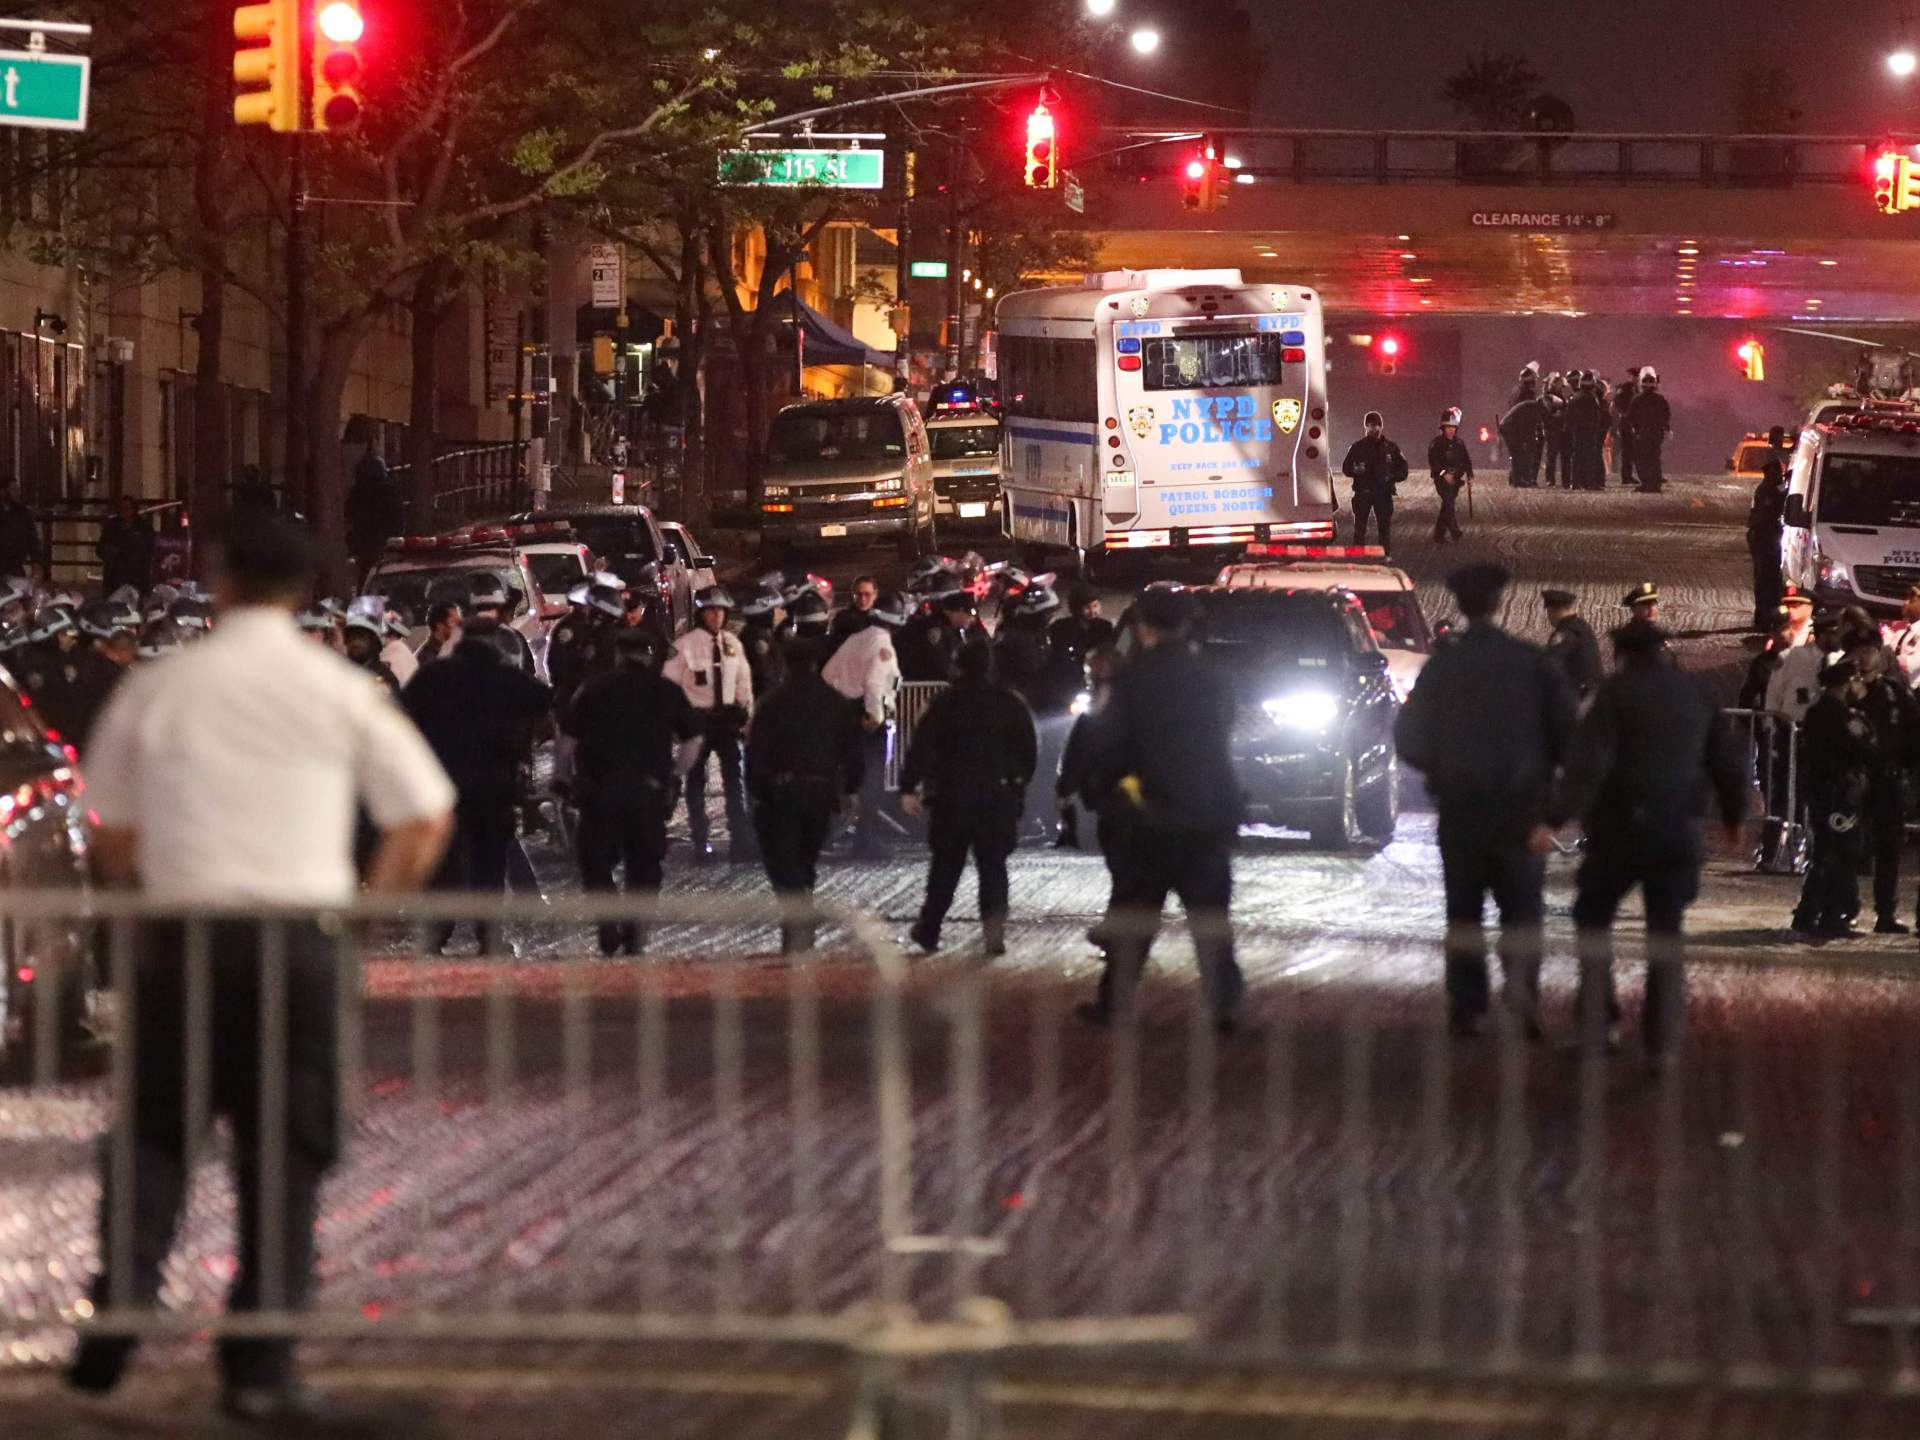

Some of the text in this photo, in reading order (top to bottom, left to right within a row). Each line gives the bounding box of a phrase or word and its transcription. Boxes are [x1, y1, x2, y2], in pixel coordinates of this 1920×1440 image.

[0, 67, 20, 108] t
[784, 158, 816, 179] 115
[826, 158, 848, 180] St
[1472, 213, 1561, 226] CLEARANCE
[1172, 395, 1258, 420] NYPD
[1159, 418, 1273, 445] POLICE
[1160, 490, 1208, 502] PATROL
[1168, 502, 1217, 516] QUEENS
